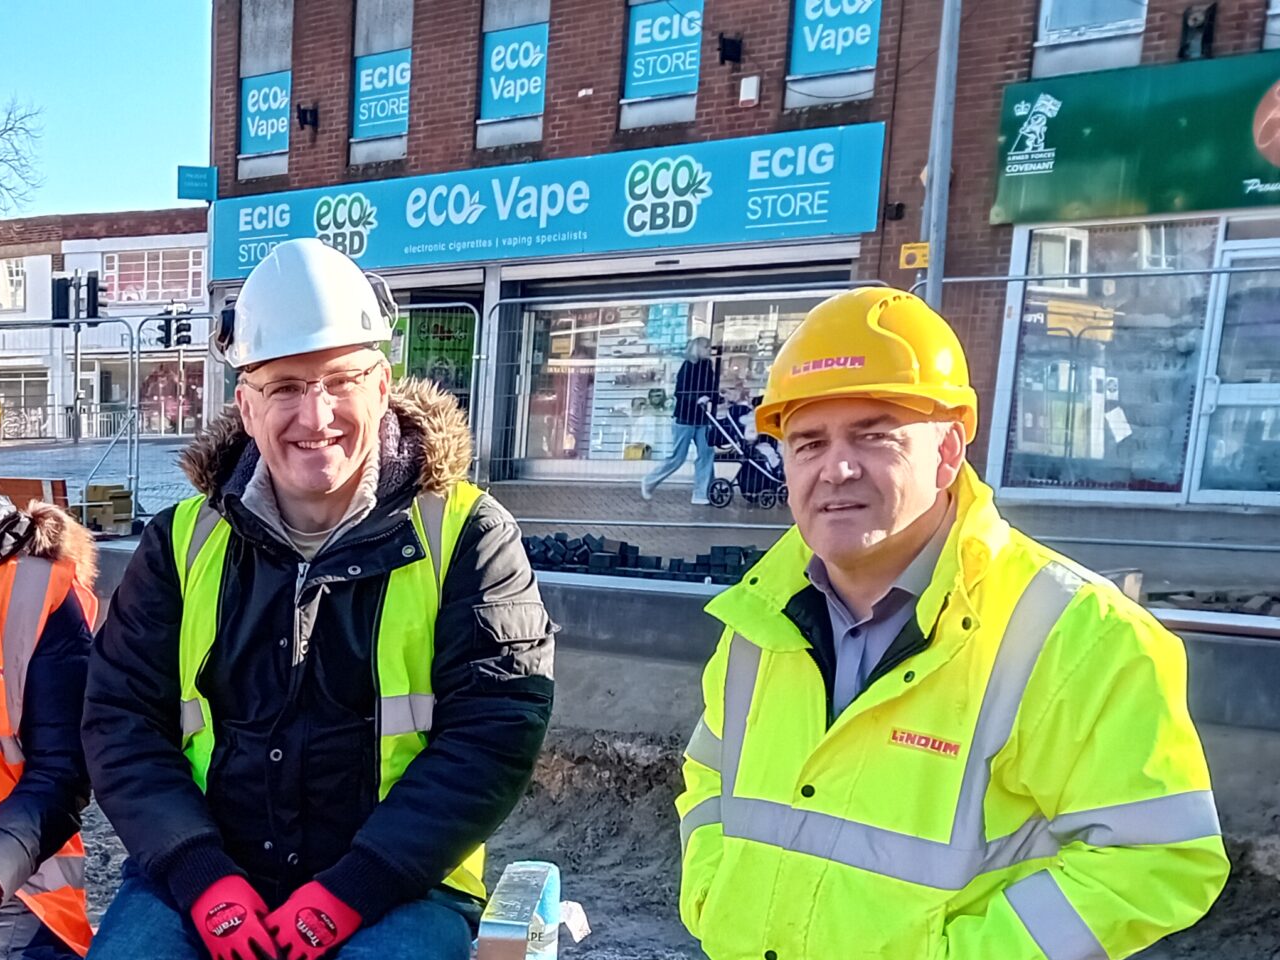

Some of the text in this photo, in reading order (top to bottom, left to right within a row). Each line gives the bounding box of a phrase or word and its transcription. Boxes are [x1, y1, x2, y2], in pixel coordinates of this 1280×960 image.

[634, 11, 701, 45] ECIG
[803, 23, 871, 55] Vape
[490, 41, 534, 72] eco
[632, 49, 697, 78] STORE
[360, 62, 410, 92] ECIG
[490, 75, 541, 103] Vape
[247, 86, 281, 113] eco
[359, 96, 408, 120] STORE
[247, 115, 287, 140] Vape
[748, 142, 835, 181] ECIG
[1006, 162, 1055, 173] COVENANT
[629, 158, 694, 201] eco
[239, 203, 290, 232] ECIG
[316, 195, 365, 231] eco
[406, 176, 590, 229] eco Vape
[627, 199, 694, 233] CBD
[747, 190, 829, 220] STORE
[403, 230, 588, 254] electronic cigarettes vaping specialists
